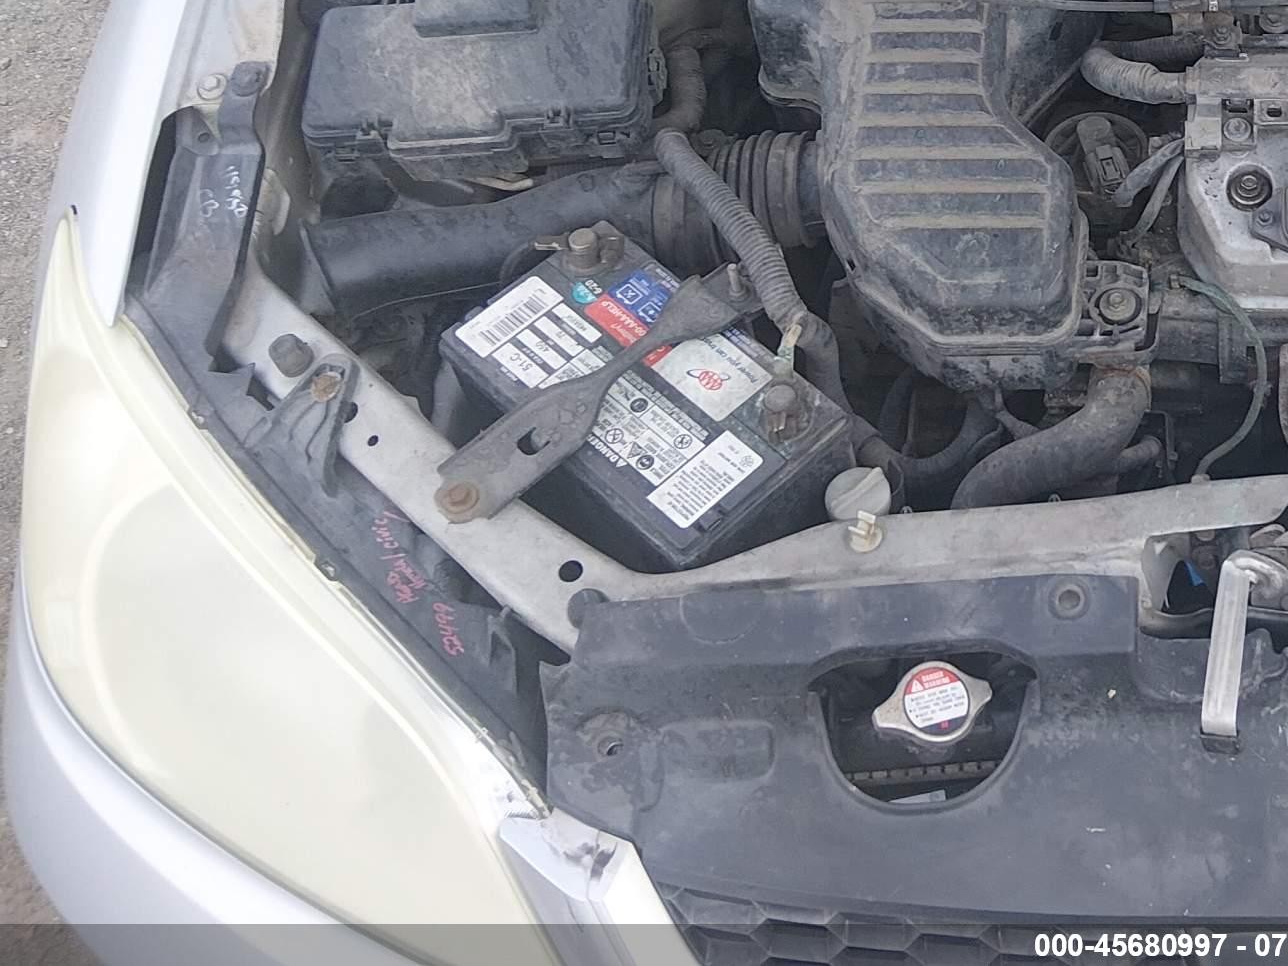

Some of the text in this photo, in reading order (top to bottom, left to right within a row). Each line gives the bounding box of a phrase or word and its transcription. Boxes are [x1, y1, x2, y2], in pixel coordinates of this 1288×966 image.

[600, 300, 648, 337] 00-AAA-HELP
[716, 347, 727, 357] can
[510, 352, 533, 372] 51-C
[727, 356, 741, 367] you
